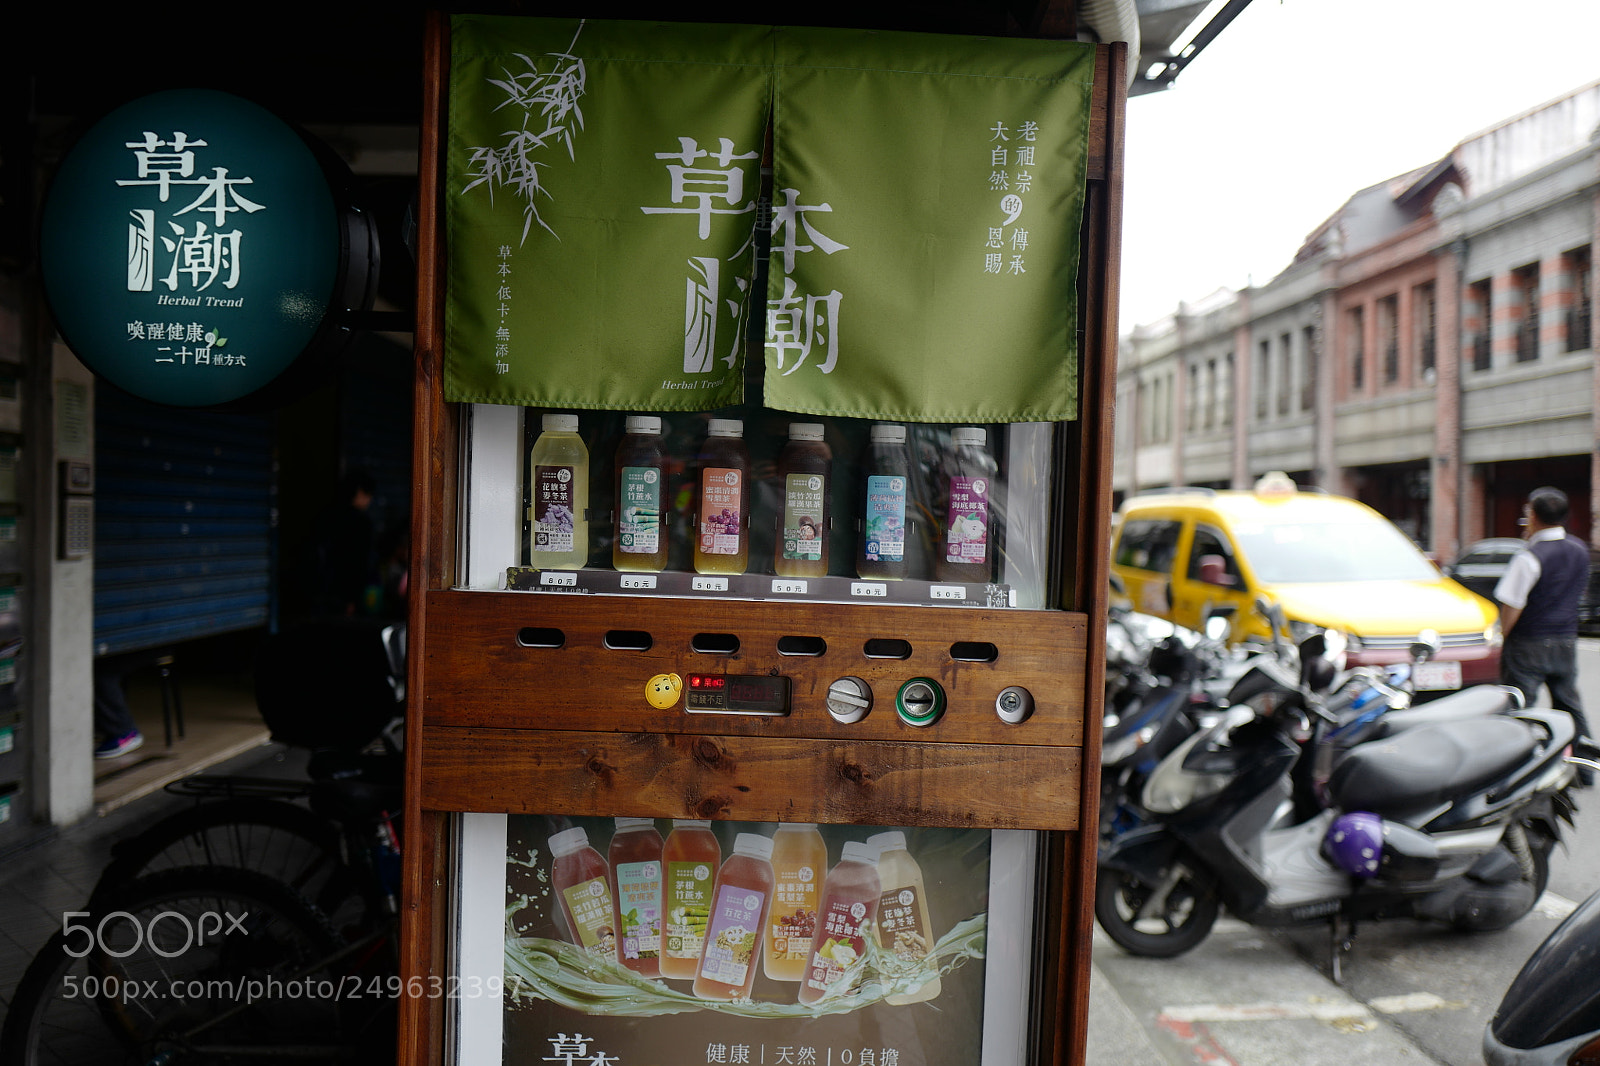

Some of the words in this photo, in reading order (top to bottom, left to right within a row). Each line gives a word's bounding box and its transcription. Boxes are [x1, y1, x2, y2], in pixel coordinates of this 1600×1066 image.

[157, 295, 201, 306] Herbal
[206, 297, 244, 308] Trend
[661, 380, 698, 390] Herbal
[675, 890, 704, 900] 竹蔗水
[724, 907, 752, 922] 五花茶
[706, 1042, 750, 1065] 健康
[775, 1046, 816, 1066] 天然
